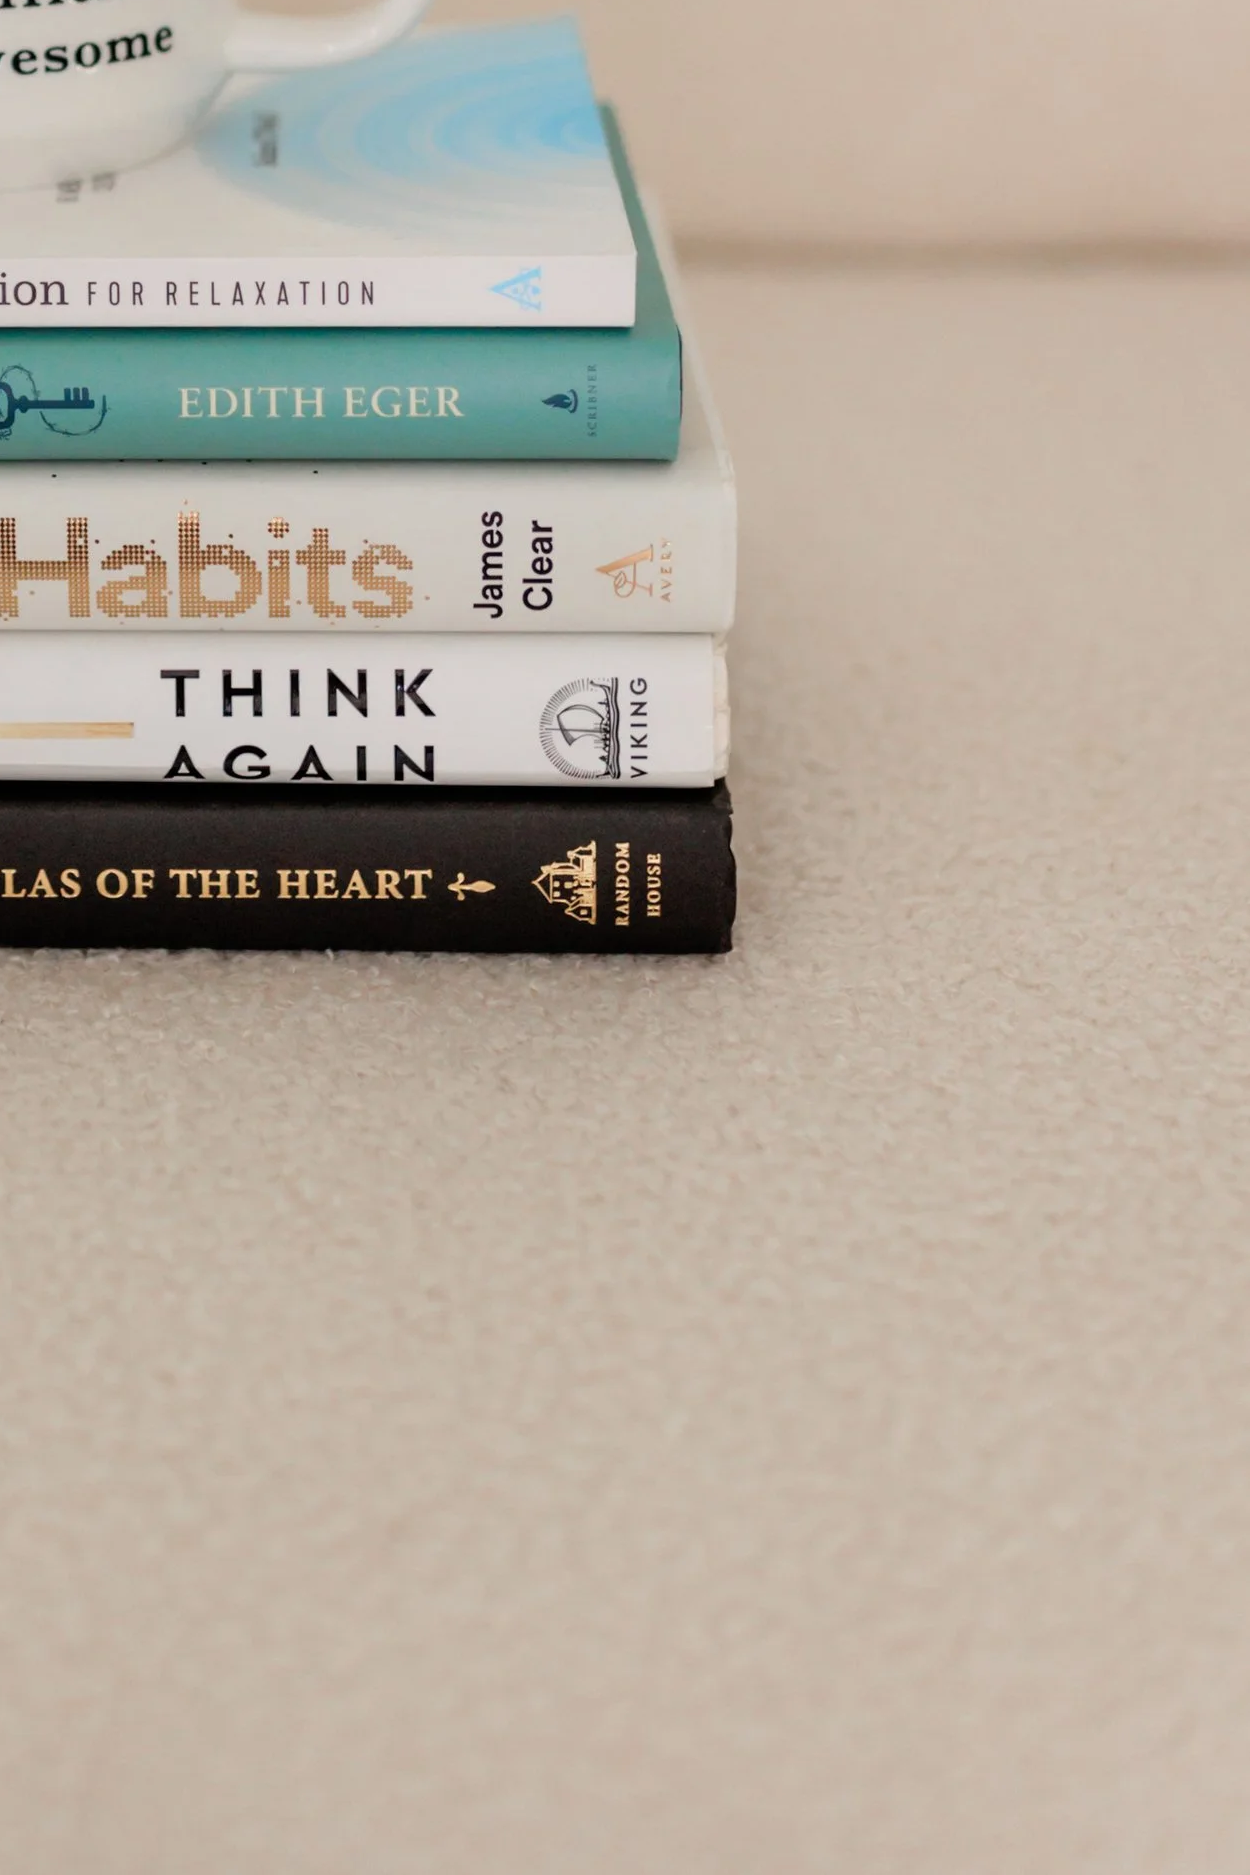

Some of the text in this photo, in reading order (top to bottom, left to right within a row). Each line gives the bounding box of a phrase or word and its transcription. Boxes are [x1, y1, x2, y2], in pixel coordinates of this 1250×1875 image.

[88, 282, 143, 305] FOR
[166, 281, 373, 305] RELAXATION
[178, 387, 465, 418] EDITH EGER
[587, 363, 597, 437] SCRIBNER
[473, 512, 503, 618] James
[523, 520, 553, 610] Clear
[660, 538, 672, 602] AVERY
[161, 669, 435, 717] THINK
[630, 678, 648, 778] VIKING
[162, 745, 435, 781] AGAIN
[97, 869, 154, 898] OF
[169, 869, 260, 898] THE
[277, 869, 432, 899] HEART
[616, 843, 629, 925] RANDOM
[647, 854, 661, 916] HOUSE
